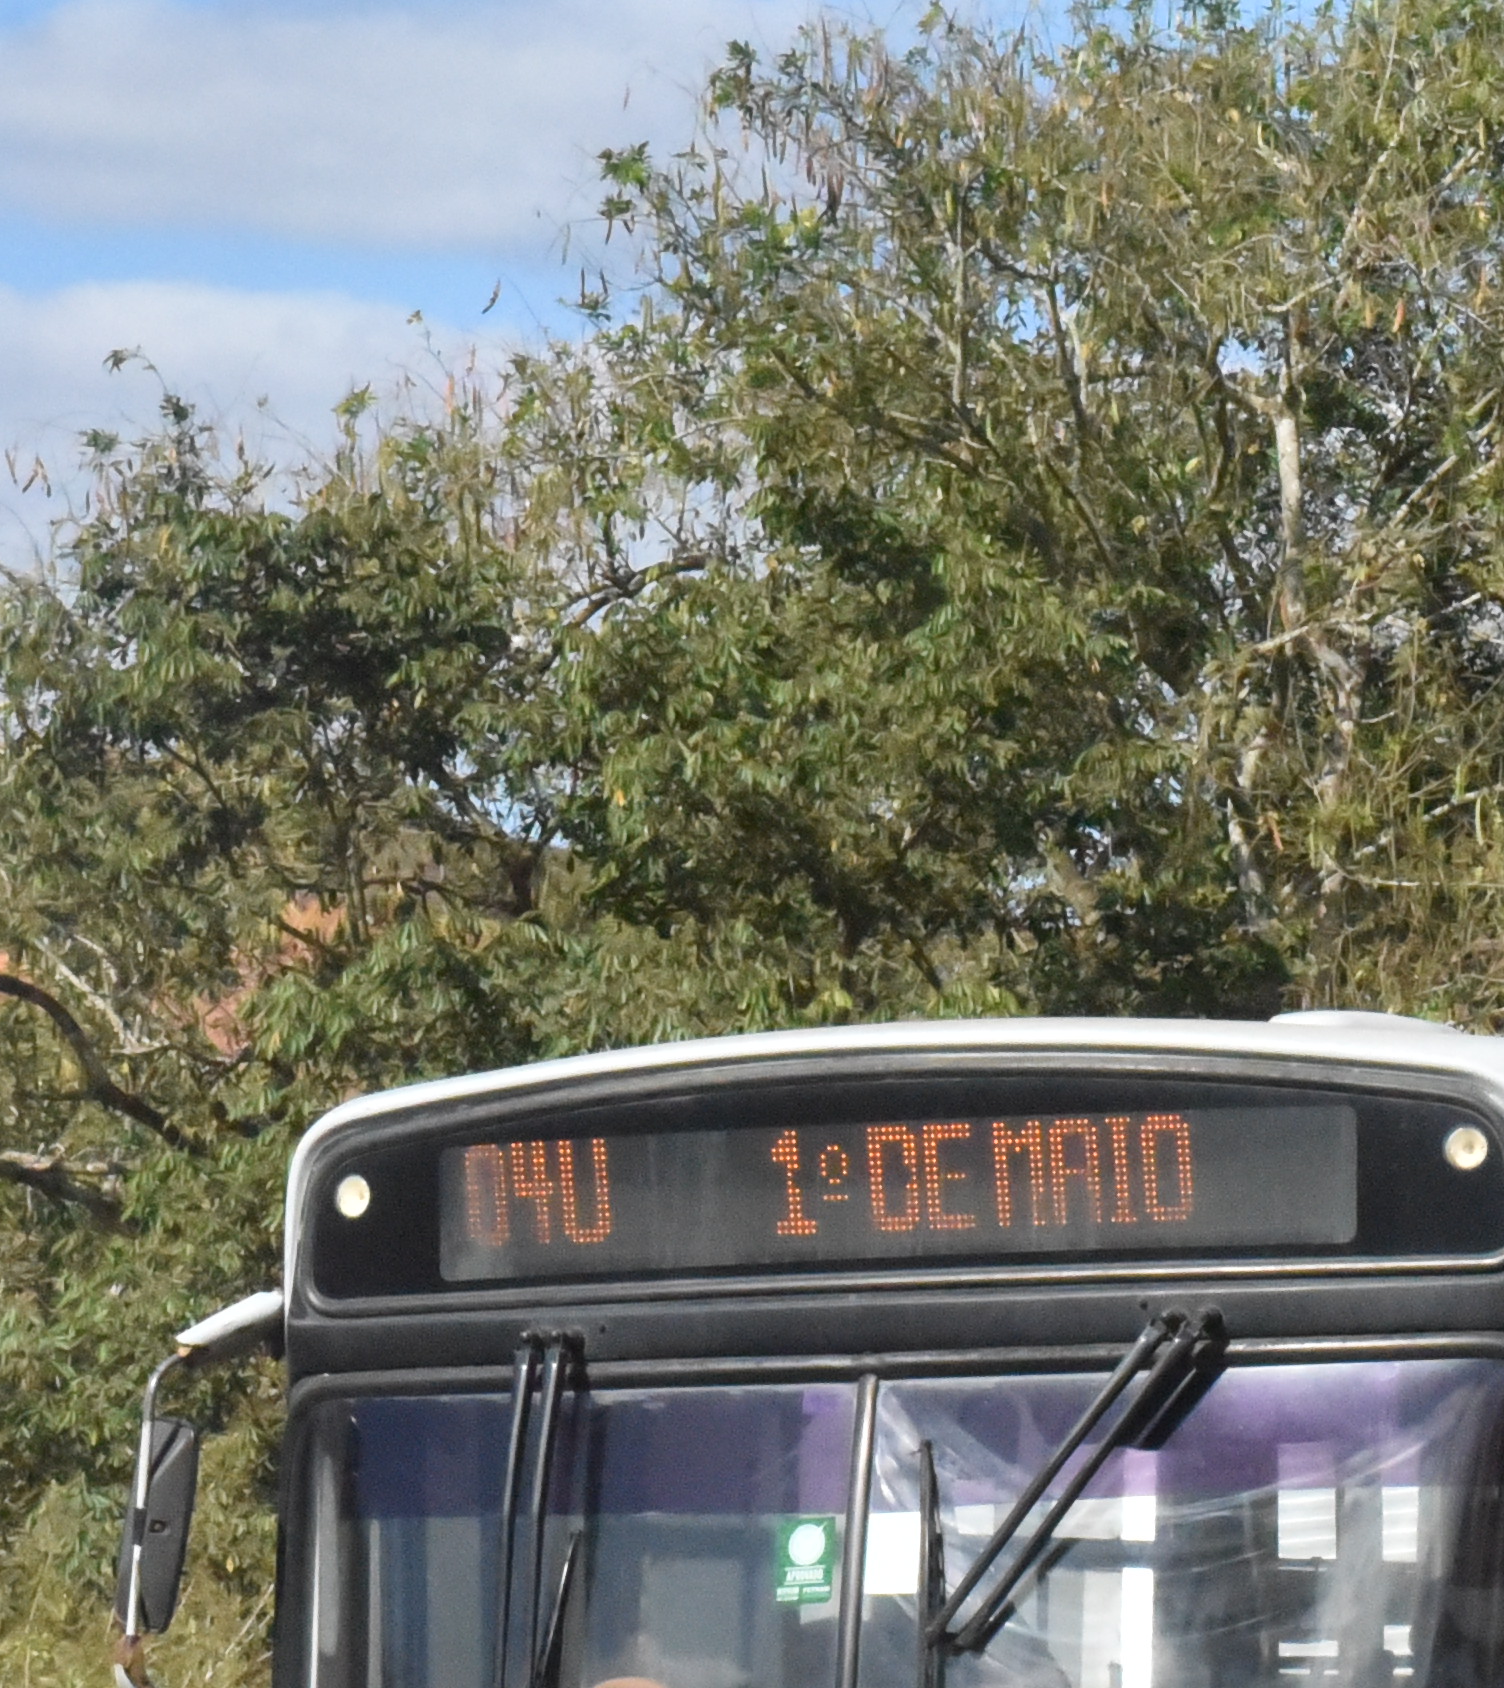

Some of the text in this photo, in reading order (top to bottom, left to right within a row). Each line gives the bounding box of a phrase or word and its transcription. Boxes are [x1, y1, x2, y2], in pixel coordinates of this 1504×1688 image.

[463, 1136, 613, 1247] 04U
[866, 1122, 976, 1232] DE
[991, 1113, 1195, 1228] MAIO
